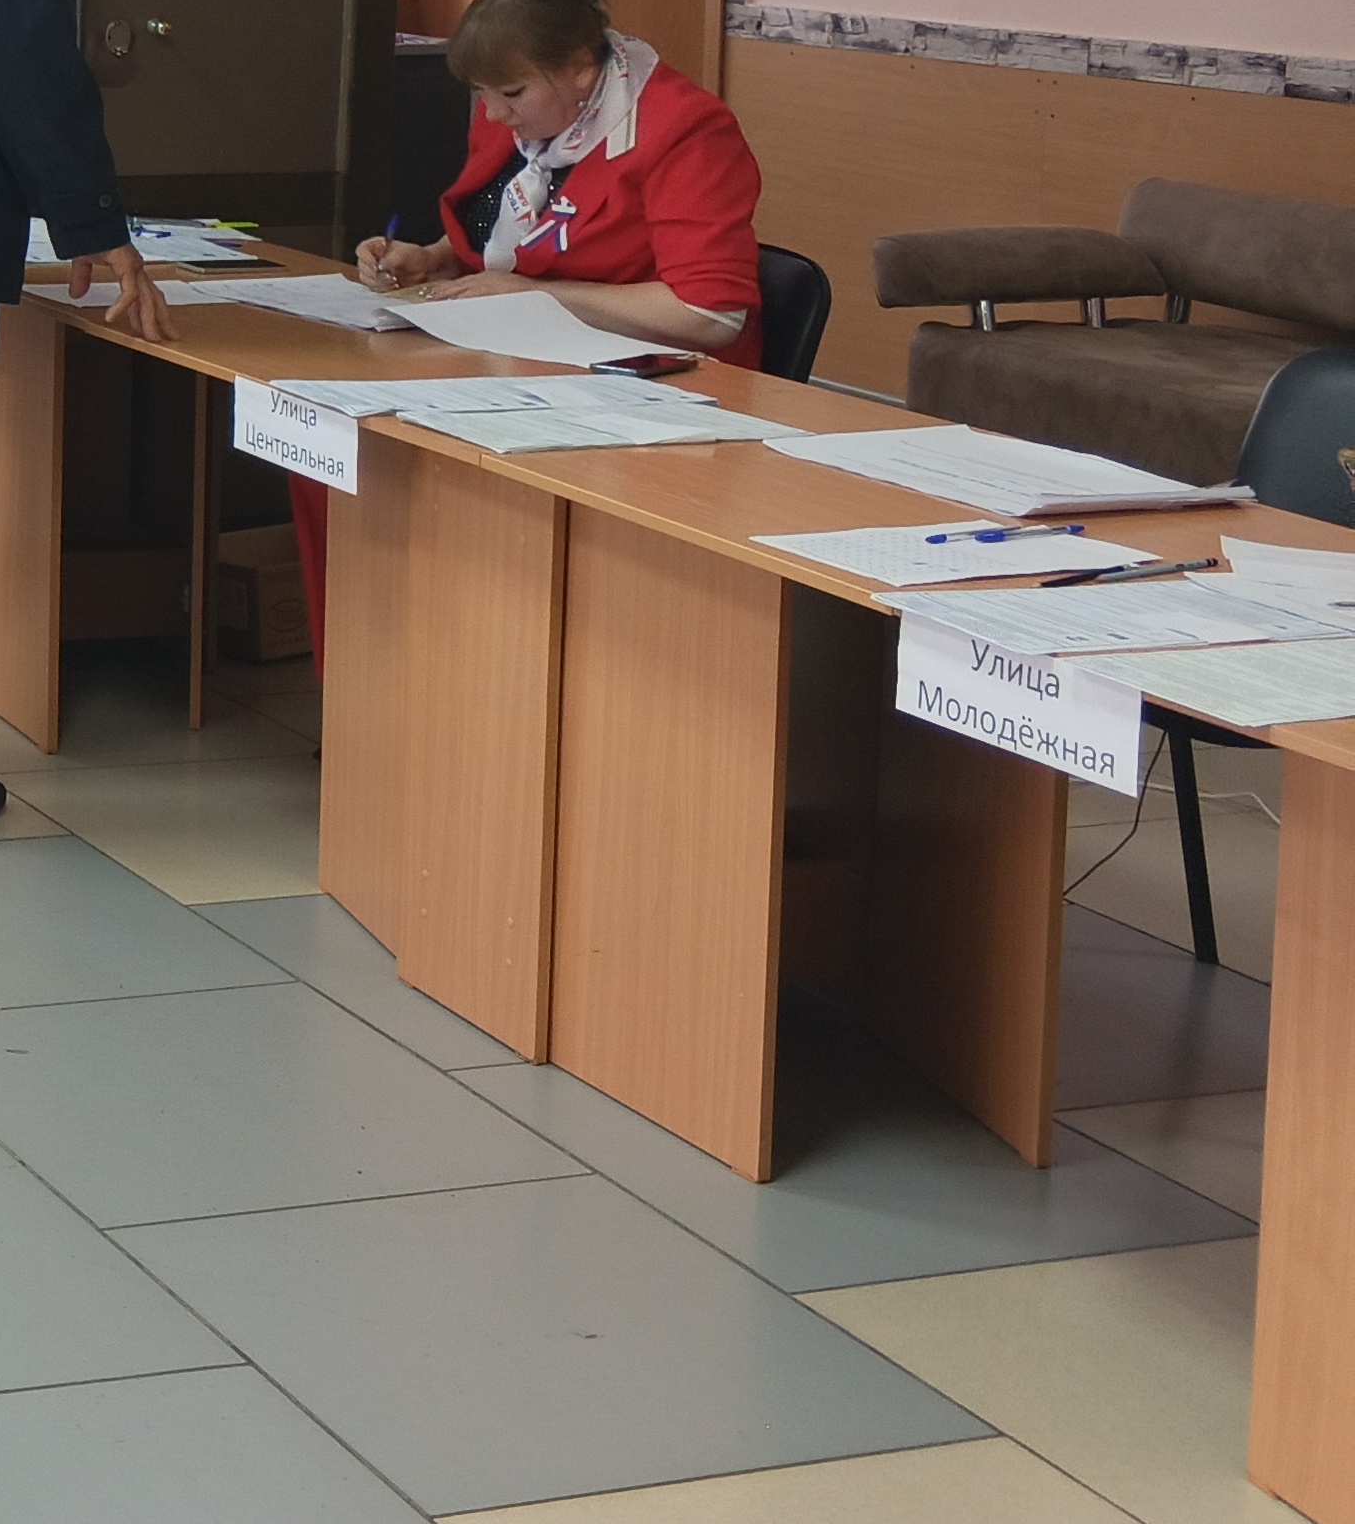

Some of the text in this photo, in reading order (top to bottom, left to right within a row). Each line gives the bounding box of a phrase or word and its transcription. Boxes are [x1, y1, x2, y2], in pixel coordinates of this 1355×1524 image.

[270, 390, 317, 429] Улица
[245, 422, 344, 479] Центральная
[970, 638, 1061, 701] Улица
[917, 680, 1116, 778] Молодёжная
